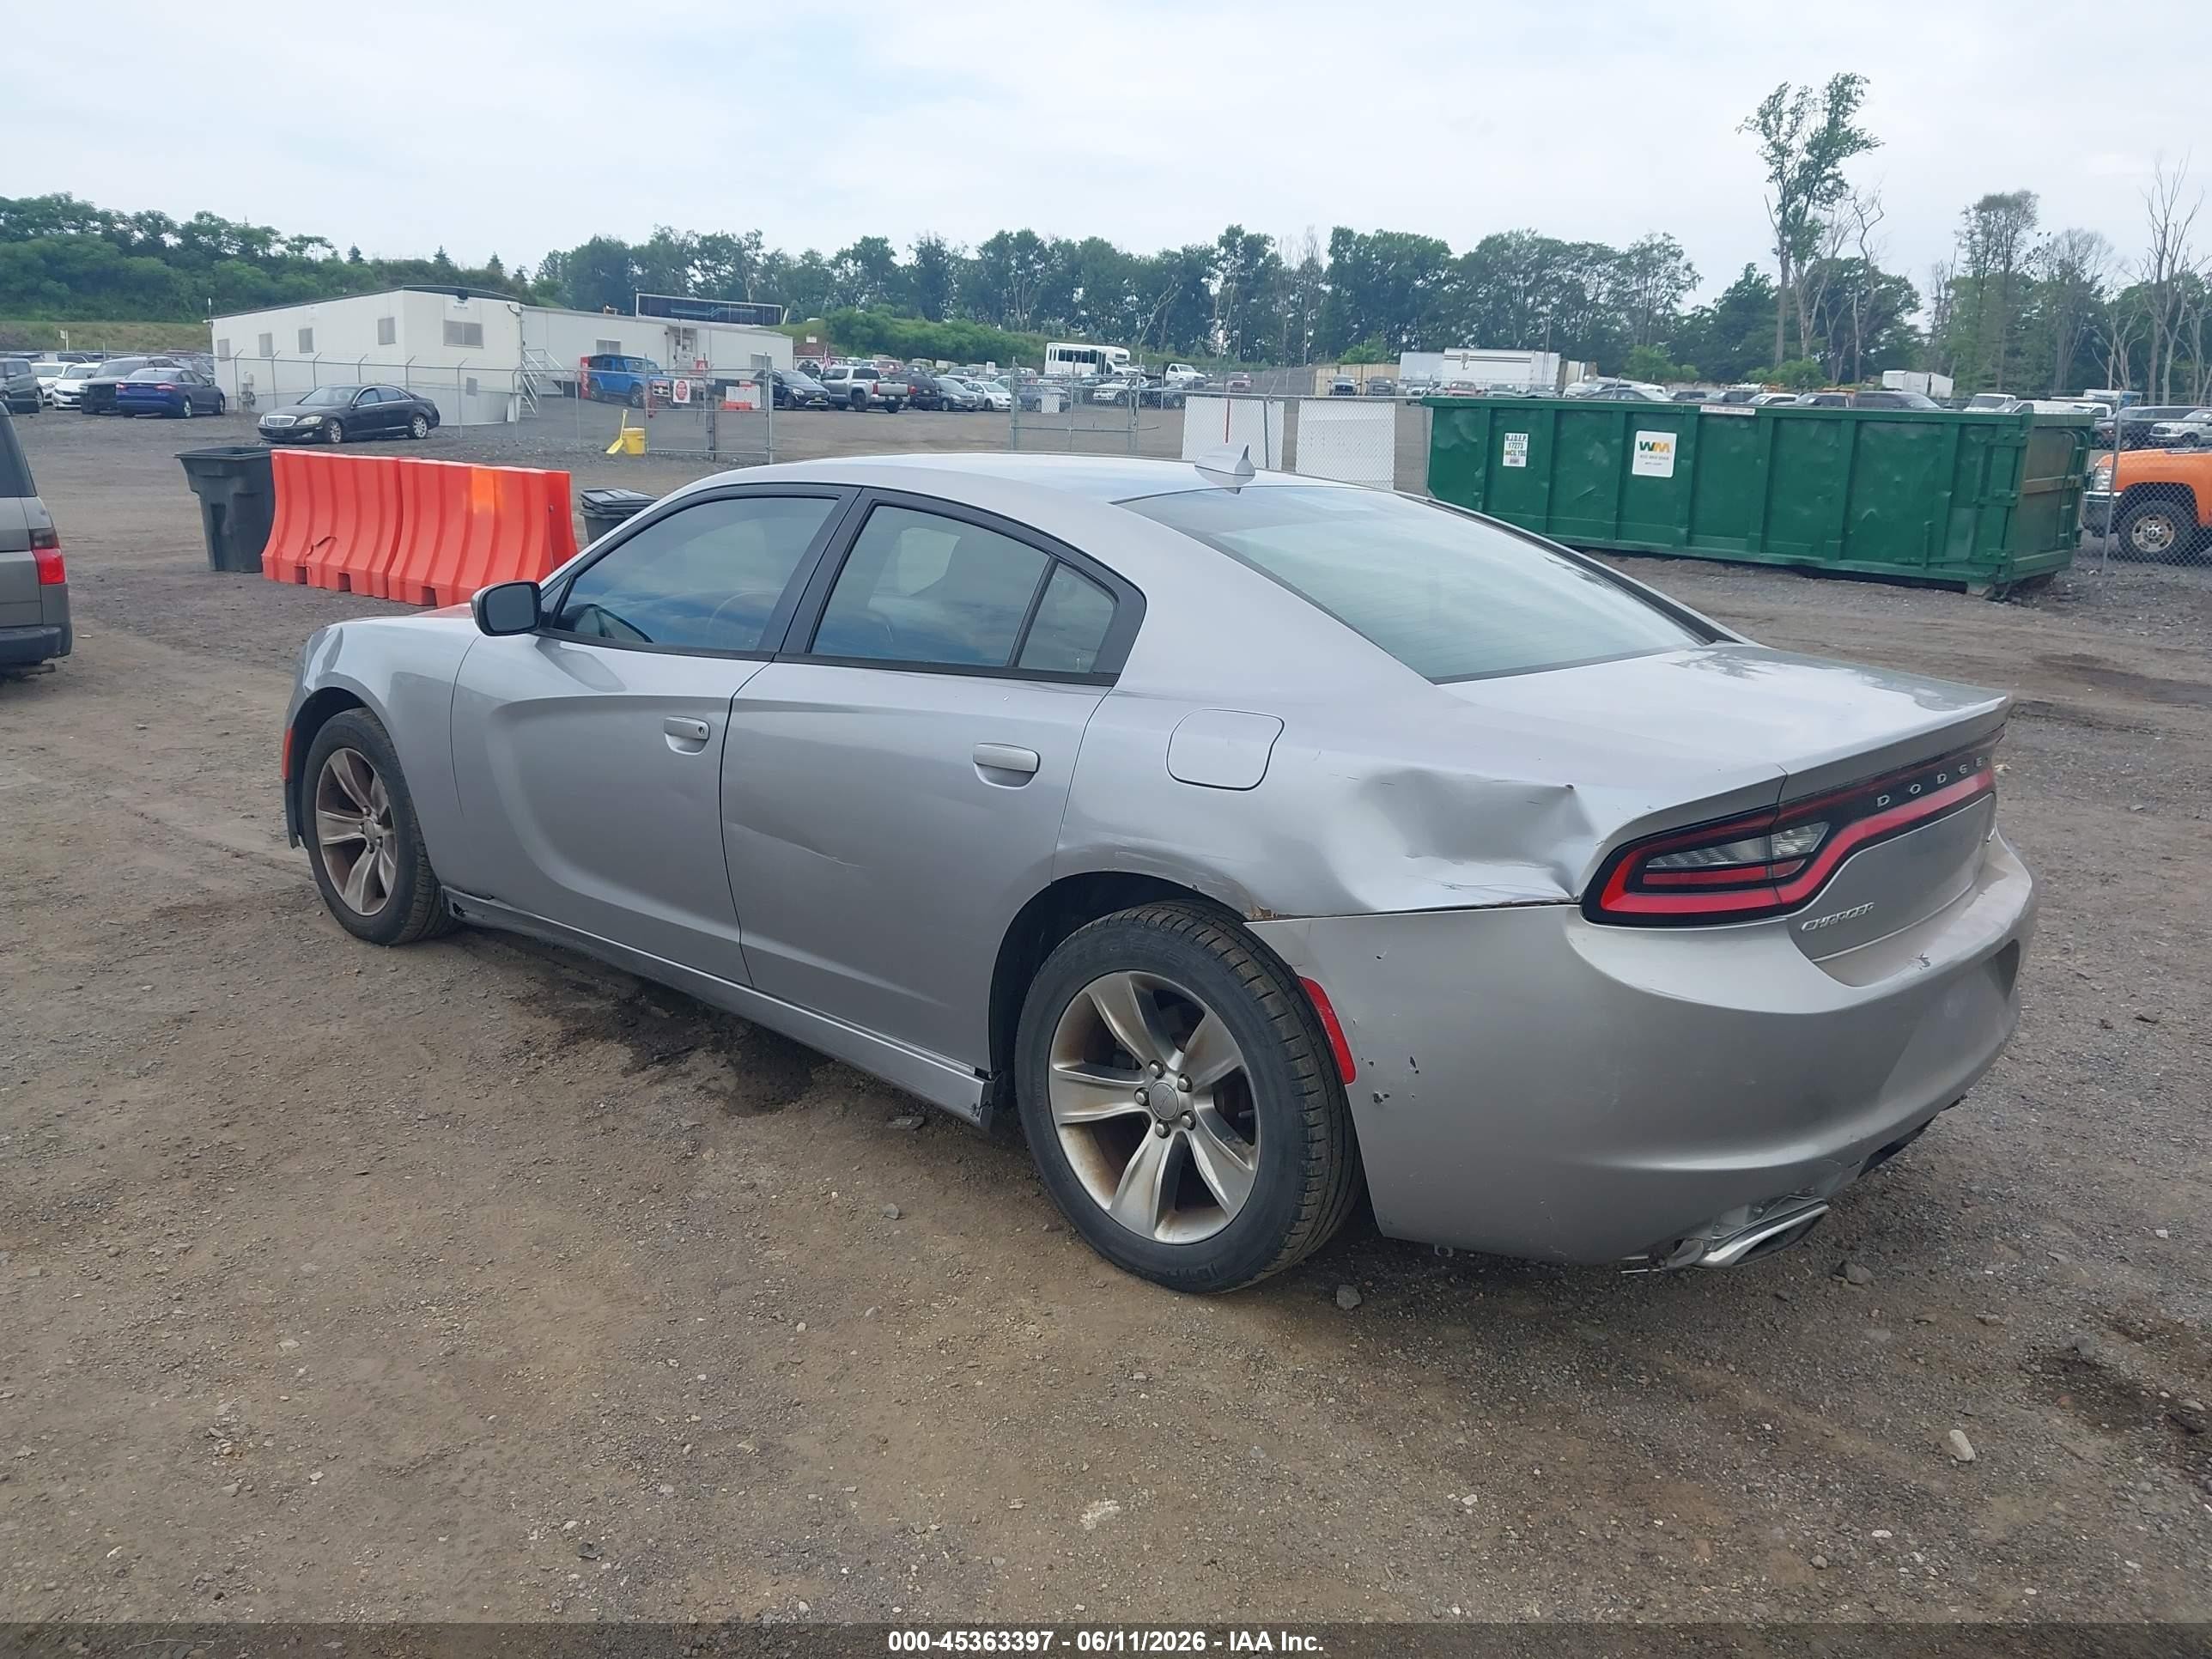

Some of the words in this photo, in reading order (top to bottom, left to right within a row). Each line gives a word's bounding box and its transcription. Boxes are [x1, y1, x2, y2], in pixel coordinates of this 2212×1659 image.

[1639, 441, 1670, 453] WM
[1876, 757, 1983, 807] DODGE
[1801, 902, 1875, 931] CHARGER
